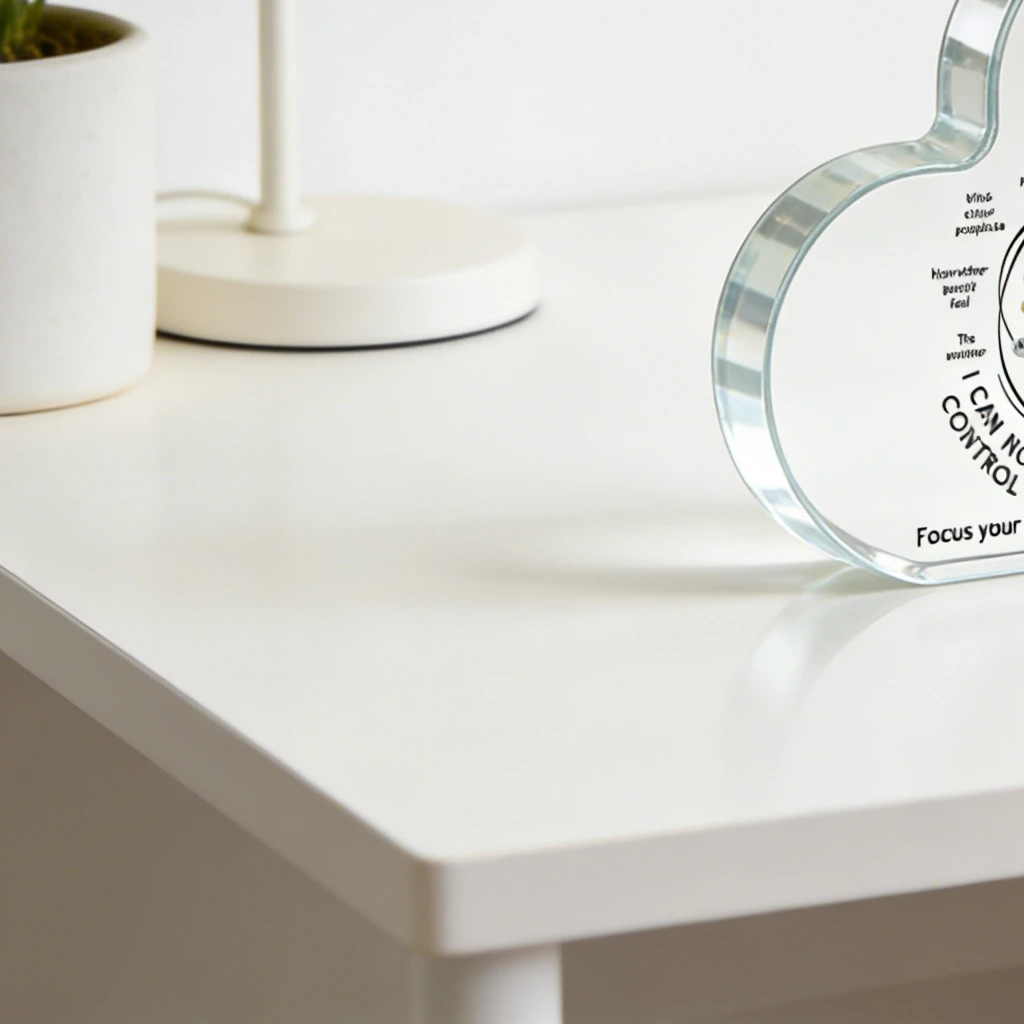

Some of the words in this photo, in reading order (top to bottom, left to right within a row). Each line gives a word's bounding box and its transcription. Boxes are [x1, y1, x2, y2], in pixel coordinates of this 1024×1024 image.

[962, 370, 980, 380] I
[970, 386, 1004, 436] CAN
[942, 395, 1018, 496] CONTROL
[917, 525, 973, 547] Focus
[978, 519, 1021, 543] your
